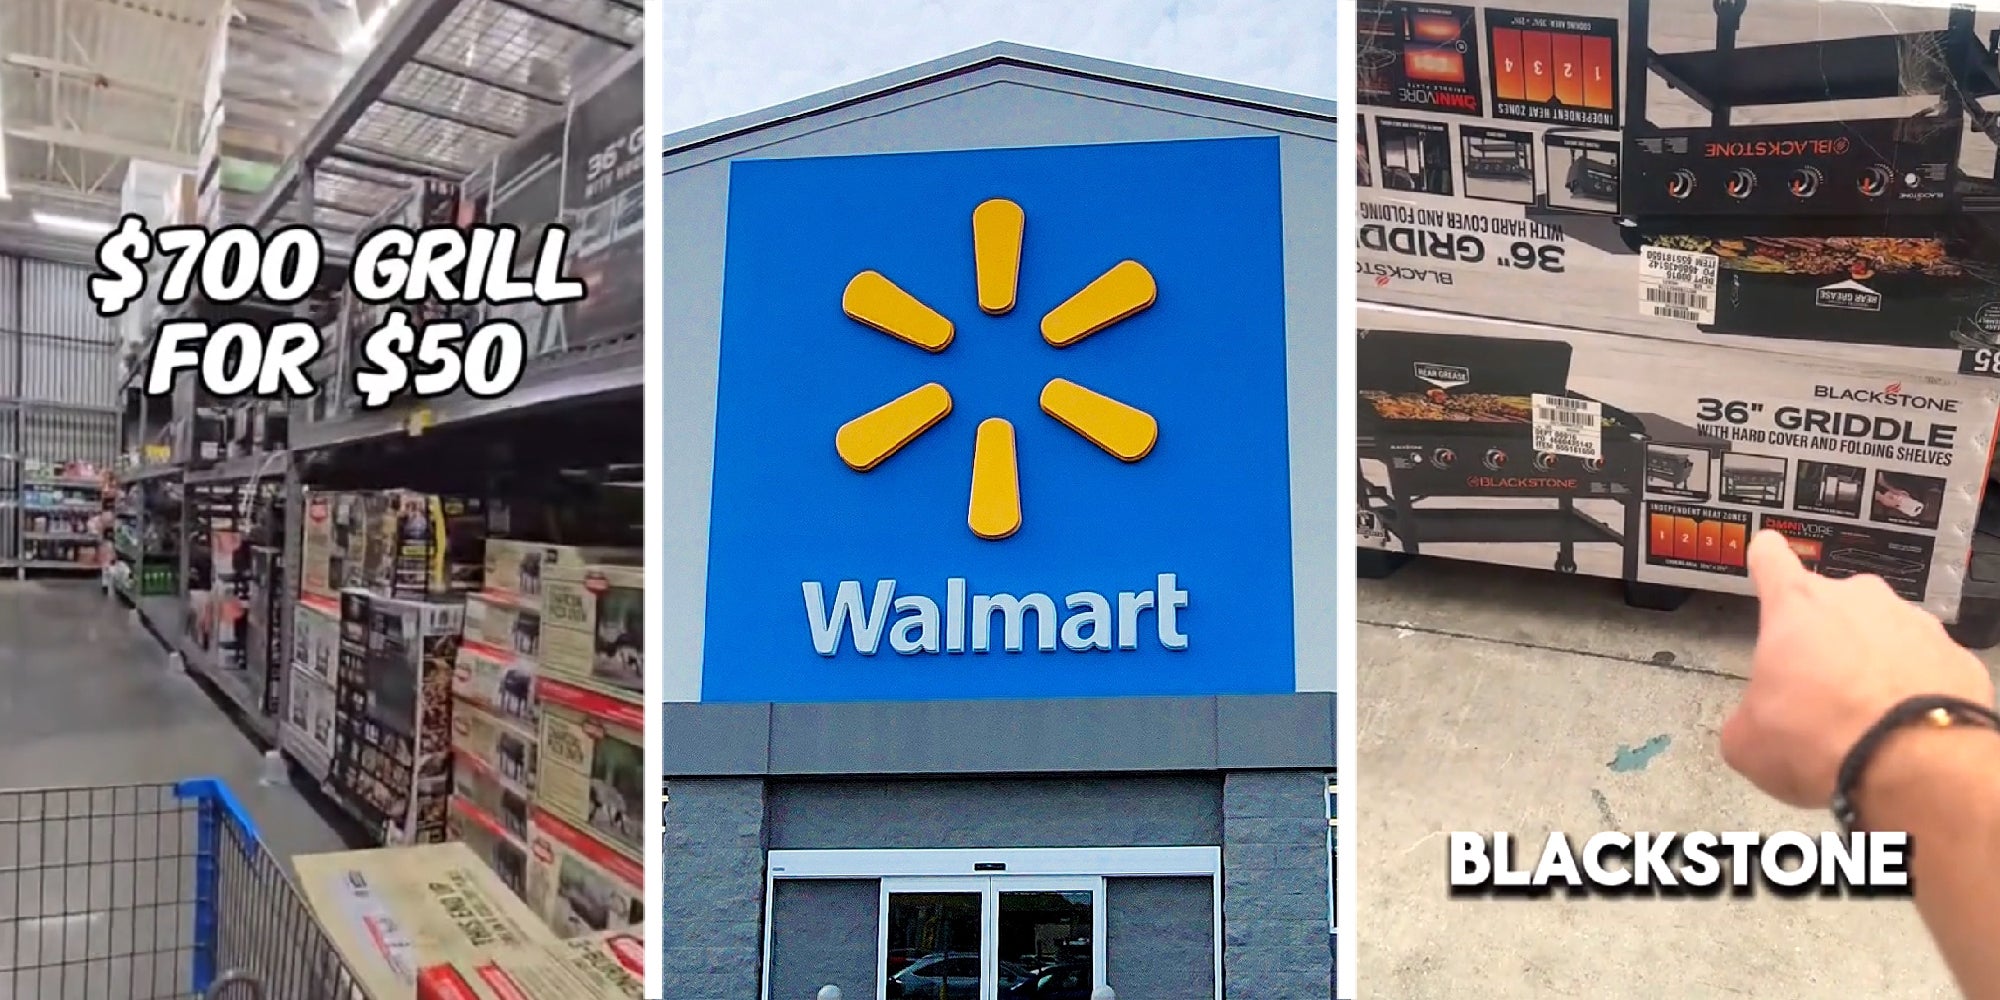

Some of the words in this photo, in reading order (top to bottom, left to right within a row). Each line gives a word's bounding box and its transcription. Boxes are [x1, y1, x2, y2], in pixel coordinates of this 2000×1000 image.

[1505, 58, 1514, 72] 4
[1534, 60, 1542, 76] 3
[1564, 62, 1572, 78] 2
[1594, 66, 1601, 81] 1
[1498, 103, 1526, 116] ZONES
[1528, 106, 1550, 118] HEAT
[1552, 109, 1613, 125] INDEPENDENT
[1704, 140, 1832, 158] BLACKSTONE
[1360, 202, 1414, 224] FOLDING
[1418, 209, 1444, 228] AND
[1447, 212, 1488, 233] COVER
[1492, 218, 1526, 238] HARD
[1530, 222, 1564, 242] WITH
[1357, 224, 1485, 263] GRIDD
[1497, 242, 1565, 273] 36"
[1696, 258, 1716, 268] ITEM
[1820, 290, 1851, 303] GREASE
[1853, 292, 1878, 304] REAR
[1814, 384, 1958, 413] BLACKSTONE
[1696, 398, 1764, 424] 36"
[1774, 406, 1957, 450] GRIDDLE
[1696, 424, 1729, 439] WITH
[1732, 428, 1766, 442] HARD
[1768, 430, 1808, 448] COVER
[1810, 436, 1838, 452] AND
[1840, 440, 1894, 460] FOLDING
[1896, 447, 1953, 466] SHELVES
[1480, 476, 1578, 488] BLACKSTONE
[1650, 503, 1701, 516] INDEPENDENT
[1702, 508, 1722, 520] HEAT
[1724, 511, 1748, 522] ZONES
[1660, 531, 1664, 540] 1
[1682, 534, 1688, 543] 2
[1706, 536, 1712, 546] 3
[1729, 540, 1736, 550] 4
[803, 573, 1189, 656] Walmart
